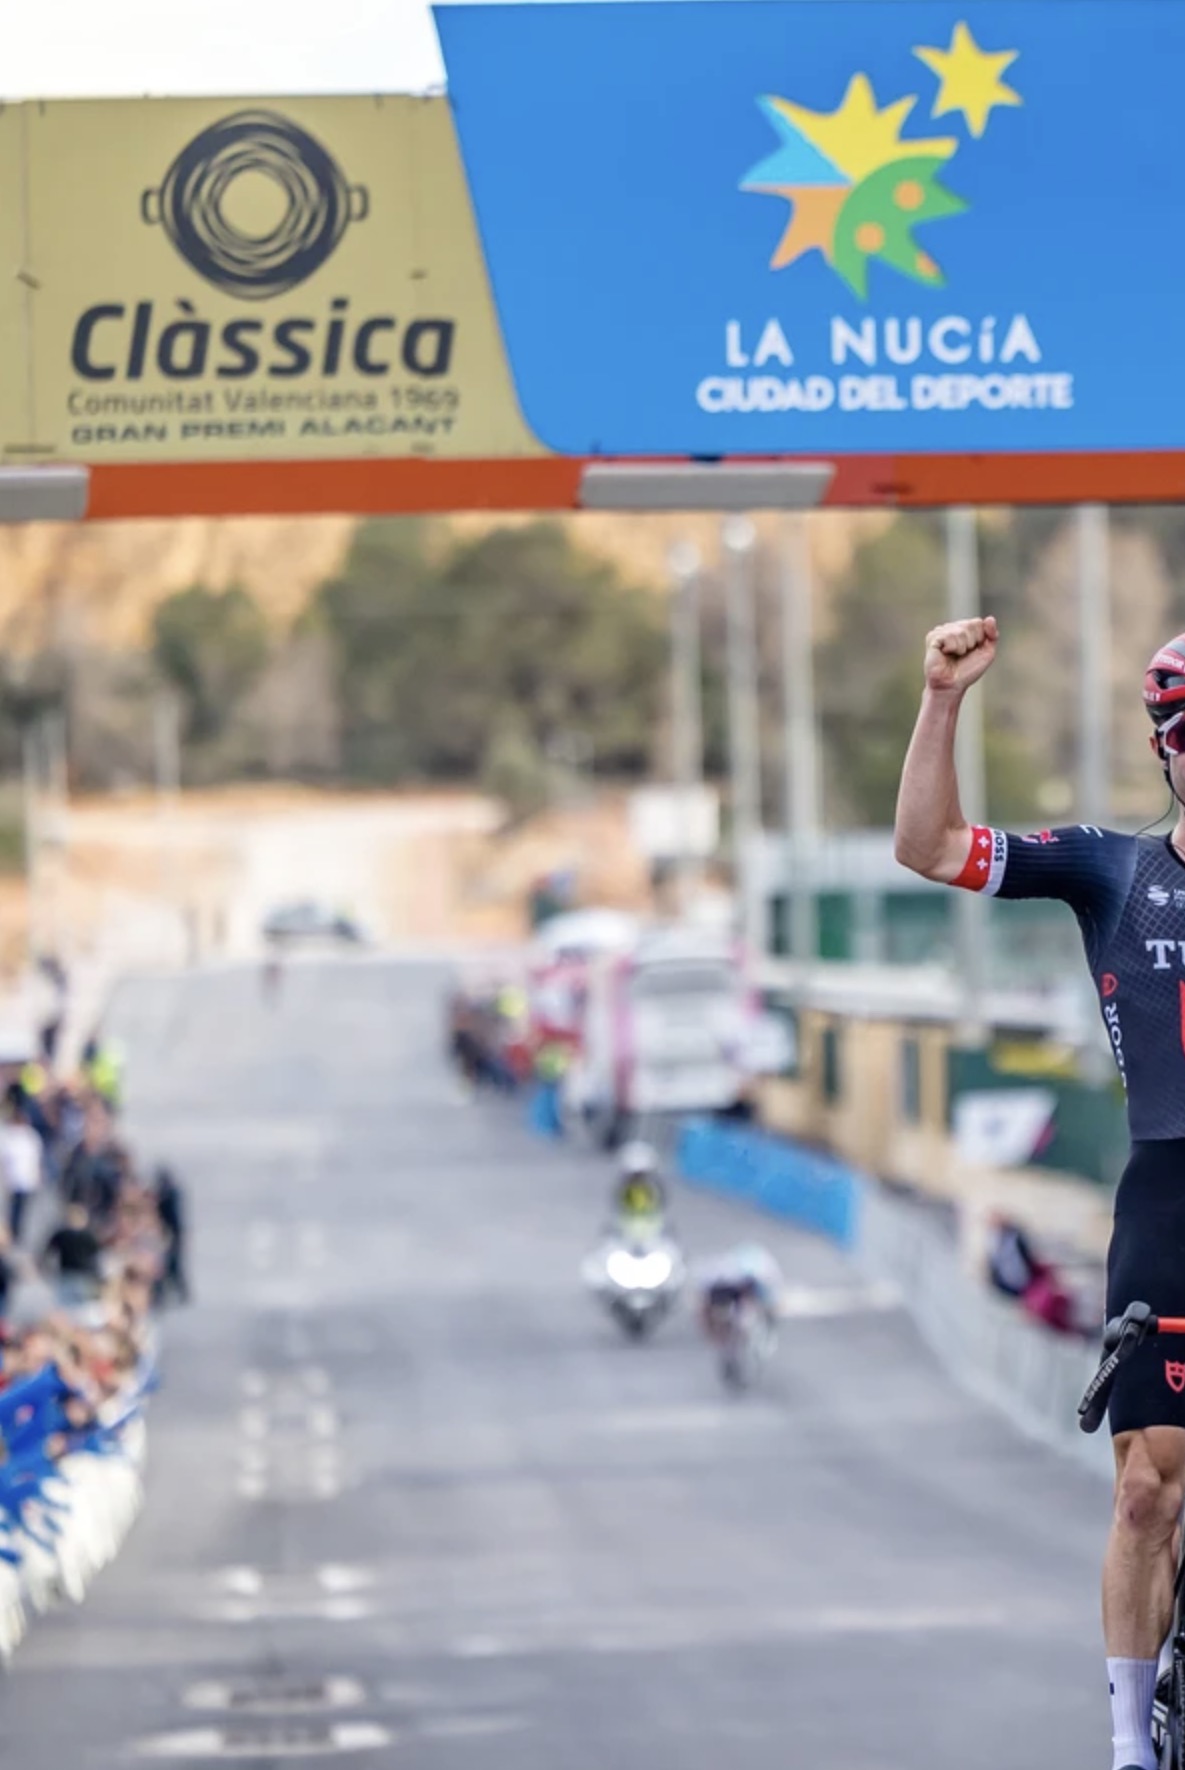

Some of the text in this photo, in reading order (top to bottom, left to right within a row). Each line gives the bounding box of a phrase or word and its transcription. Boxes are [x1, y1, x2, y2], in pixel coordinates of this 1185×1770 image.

[71, 297, 456, 381] Clàssica
[726, 318, 794, 367] LA
[67, 384, 459, 416] Comunitat Valenciana 1969
[696, 372, 1074, 412] CIUDAD DEL DEPORTE
[71, 415, 457, 445] GRAN PREMI ALACANT
